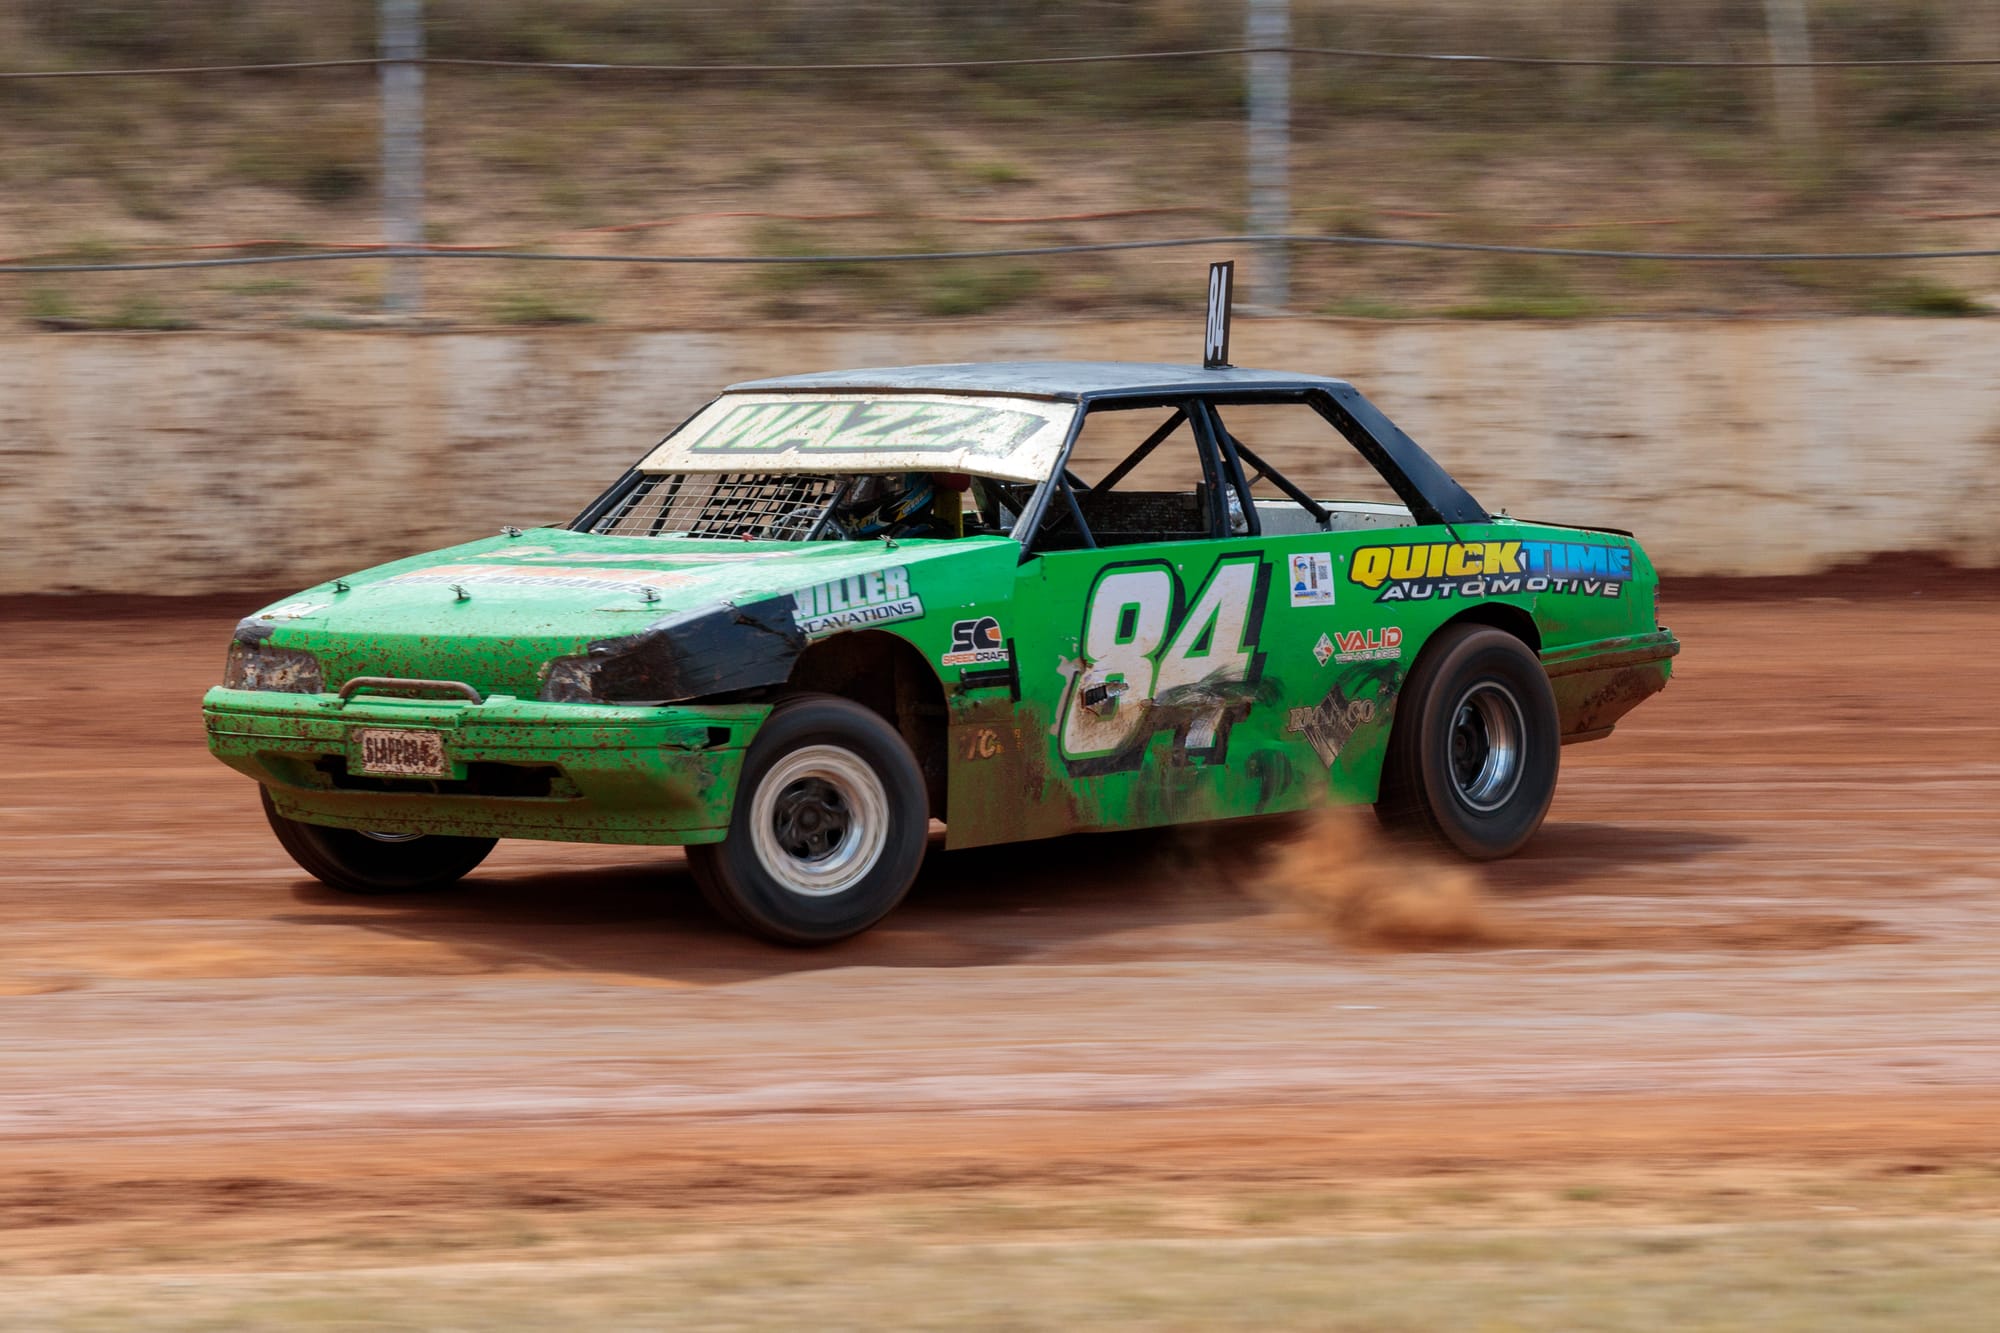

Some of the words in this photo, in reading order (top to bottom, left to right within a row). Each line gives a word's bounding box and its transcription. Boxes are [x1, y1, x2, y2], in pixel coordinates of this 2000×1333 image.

[1206, 265, 1228, 361] 84
[691, 402, 1042, 457] WAZZA
[1381, 576, 1620, 601] AUTOMOTIVE
[942, 650, 1010, 666] SPEEDCRAFT
[1060, 555, 1260, 760] 84
[1335, 627, 1403, 653] VALID
